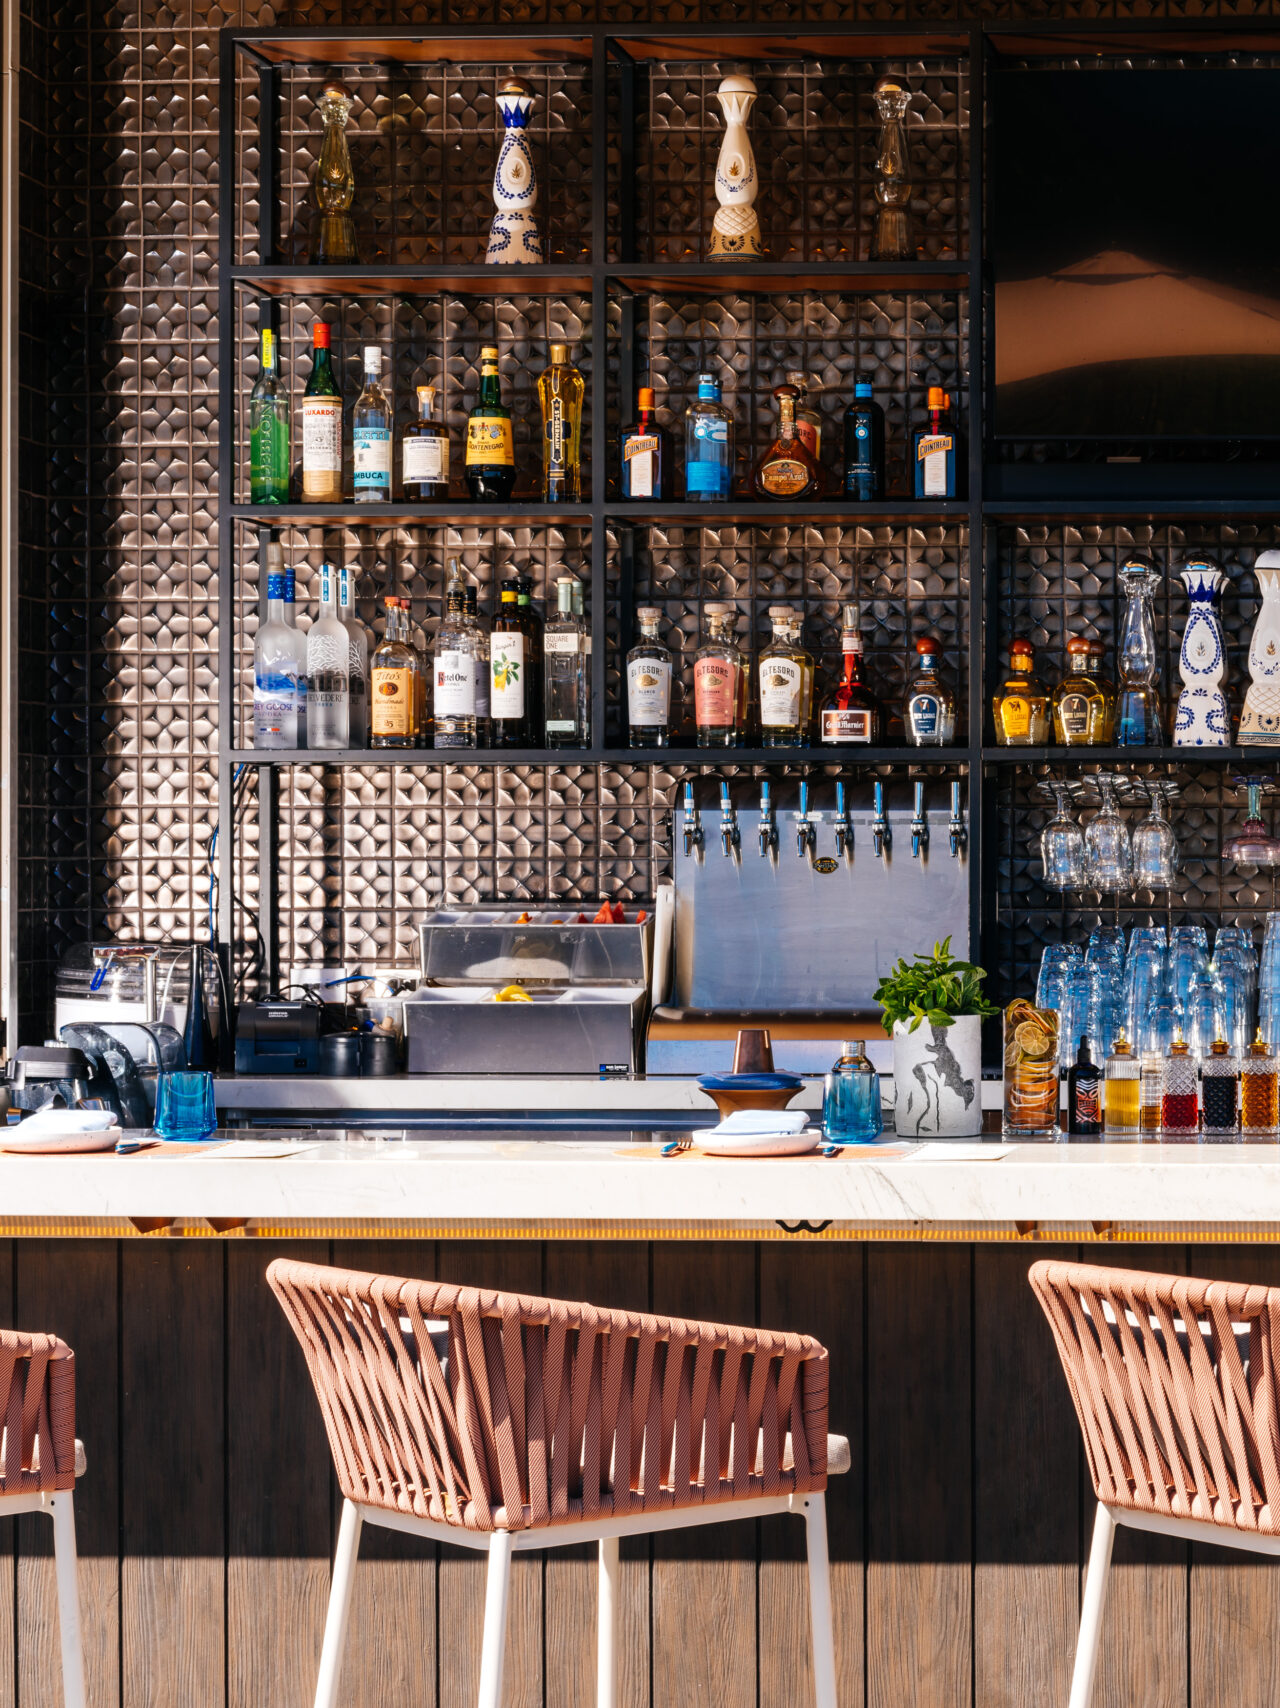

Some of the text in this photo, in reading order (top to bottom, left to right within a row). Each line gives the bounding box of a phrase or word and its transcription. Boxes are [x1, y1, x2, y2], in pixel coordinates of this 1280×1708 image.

[919, 439, 951, 457] COINTREAU
[546, 635, 569, 643] SQUARE
[546, 642, 558, 650] ONE
[376, 671, 402, 681] Tito's
[769, 665, 795, 678] TESORO
[454, 673, 468, 682] One
[921, 699, 928, 711] 7
[1072, 698, 1080, 710] 7
